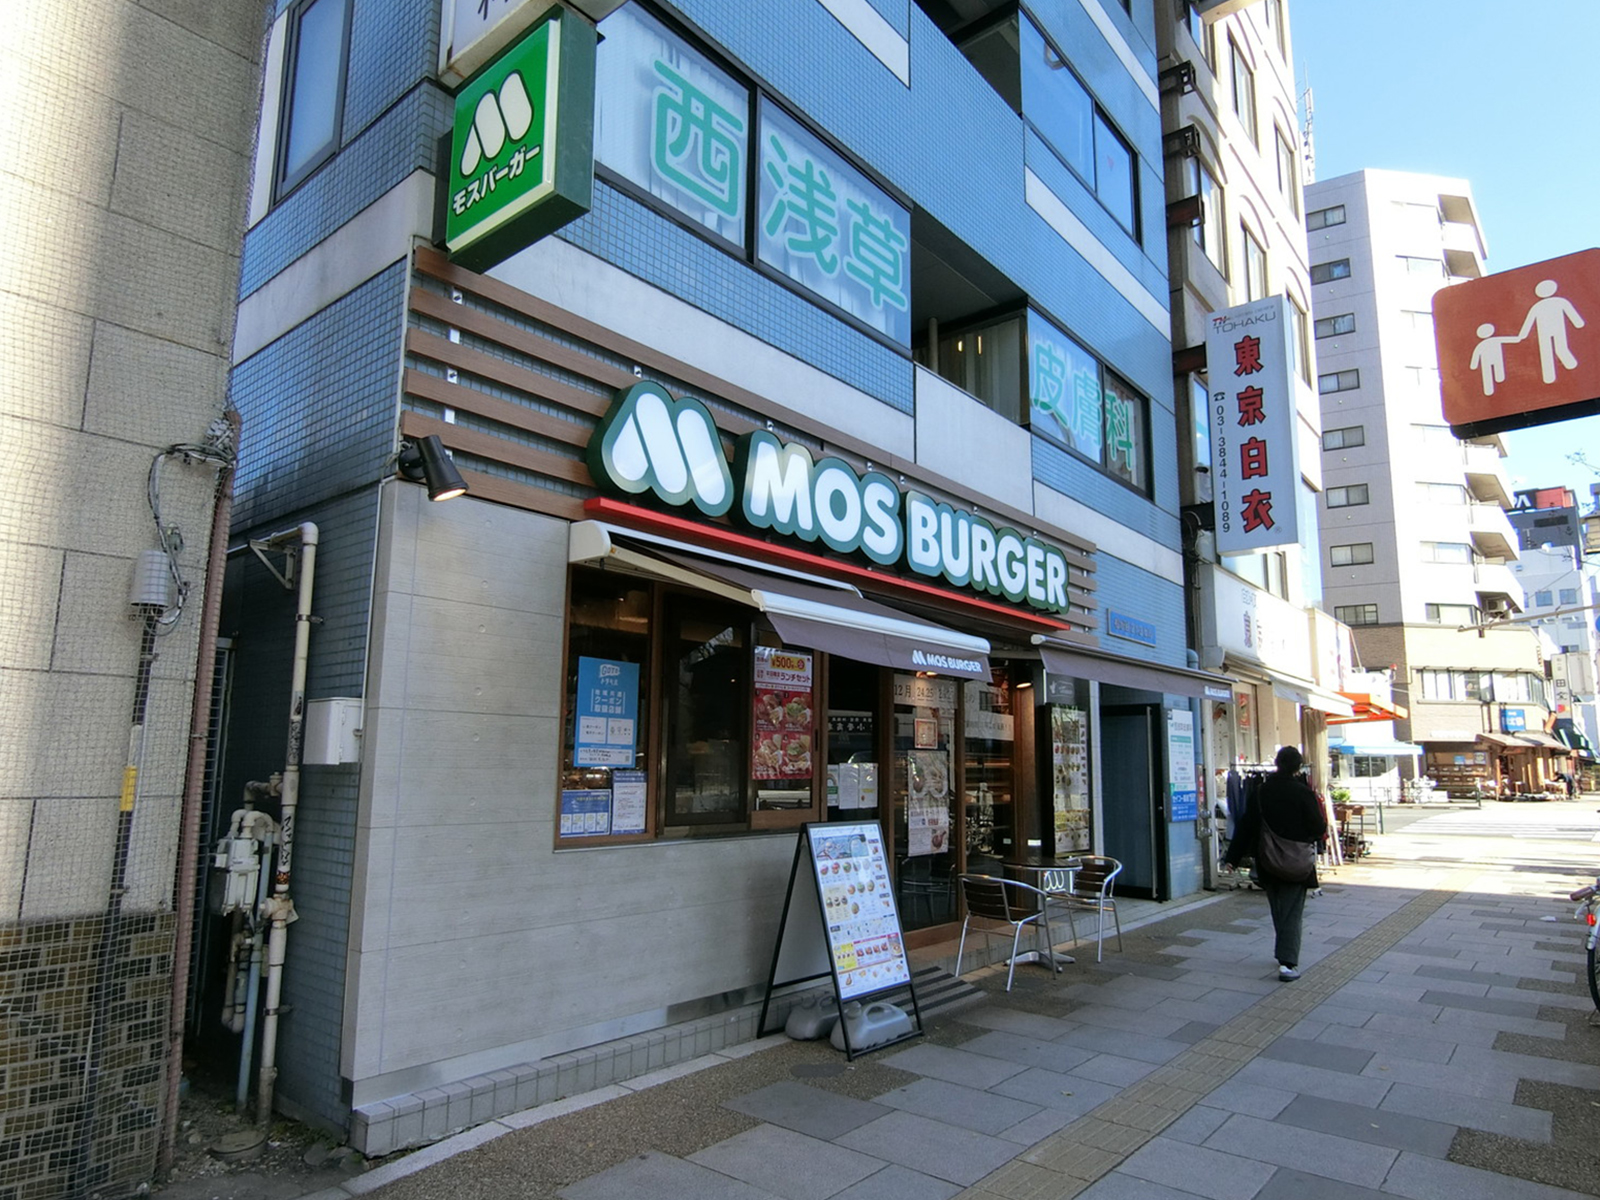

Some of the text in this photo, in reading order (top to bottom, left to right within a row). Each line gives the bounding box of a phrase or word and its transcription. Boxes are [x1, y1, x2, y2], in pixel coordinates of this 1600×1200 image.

[452, 144, 541, 216] モスバーガー
[652, 57, 1134, 472] 西浅草 皮膚科
[1213, 311, 1276, 334] TOHAKU
[1215, 404, 1231, 533] 03-3844-1089
[1233, 334, 1276, 534] 東京白衣
[747, 437, 1070, 611] MOS BURGER
[926, 653, 983, 673] MOS BURGER
